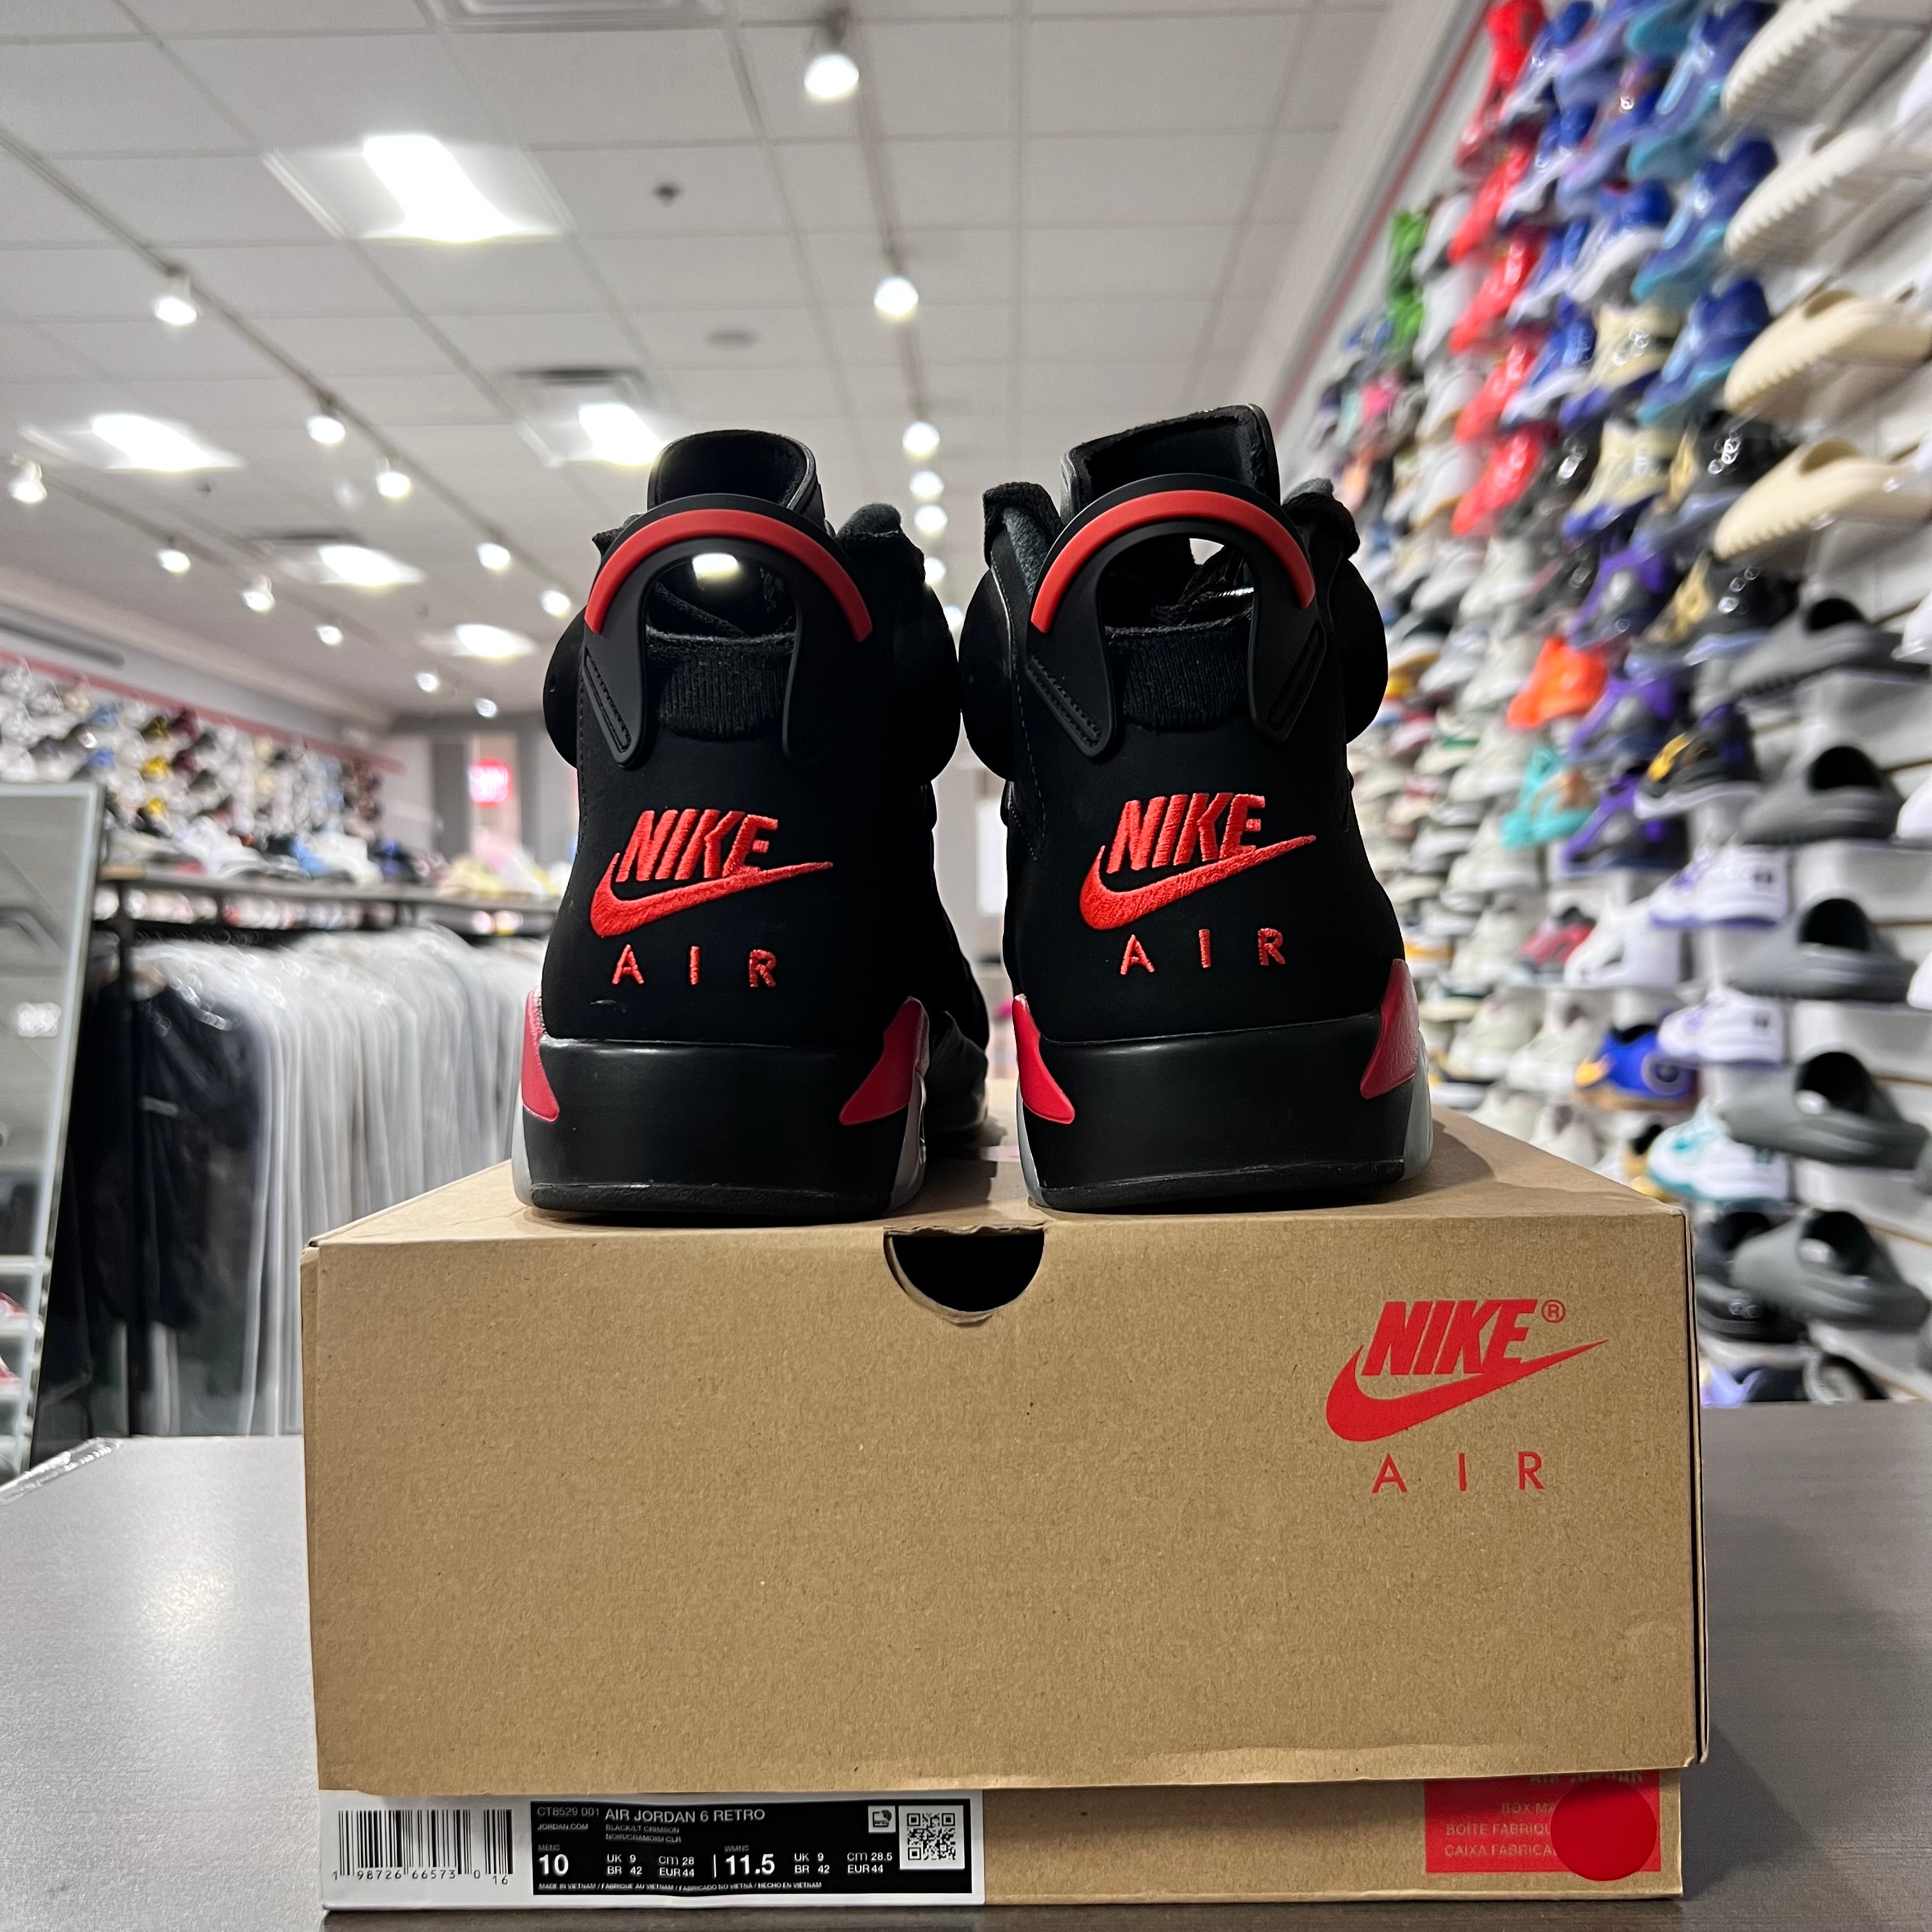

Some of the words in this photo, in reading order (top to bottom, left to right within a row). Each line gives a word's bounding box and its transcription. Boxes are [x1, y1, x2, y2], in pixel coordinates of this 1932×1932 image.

[1107, 792, 1266, 873] NIKE
[615, 809, 778, 882] NIKE
[1120, 928, 1286, 976] AIR
[611, 944, 778, 988] AIR
[1372, 1451, 1545, 1493] AIR
[537, 1807, 578, 1816] CT8529
[581, 1807, 600, 1816] 001
[1536, 1802, 1554, 1813] MA
[605, 1809, 630, 1821] AIR
[634, 1810, 695, 1823] JORDAN
[700, 1810, 709, 1821] 6
[714, 1809, 765, 1821] RETRO
[643, 1825, 680, 1834] CRIMSON
[794, 1853, 809, 1862] UK
[817, 1853, 824, 1862] 9
[871, 1852, 893, 1862] 28.5
[1445, 1844, 1487, 1857] CAIXA
[539, 1853, 569, 1875] 10
[607, 1853, 622, 1863] UK
[629, 1854, 636, 1864] 9
[682, 1857, 694, 1866] 28
[726, 1853, 776, 1876] 11.5
[607, 1866, 622, 1875] BR
[630, 1866, 643, 1875] 42
[659, 1867, 681, 1877] EUR
[682, 1868, 694, 1878] 44
[794, 1864, 809, 1874] BR
[818, 1864, 830, 1874] 42
[847, 1864, 870, 1874] EUR
[871, 1864, 884, 1874] 44
[332, 1871, 338, 1881] 1
[357, 1870, 402, 1880] 98726
[412, 1869, 456, 1880] 66573
[473, 1869, 480, 1879] 0
[493, 1874, 509, 1885] 16
